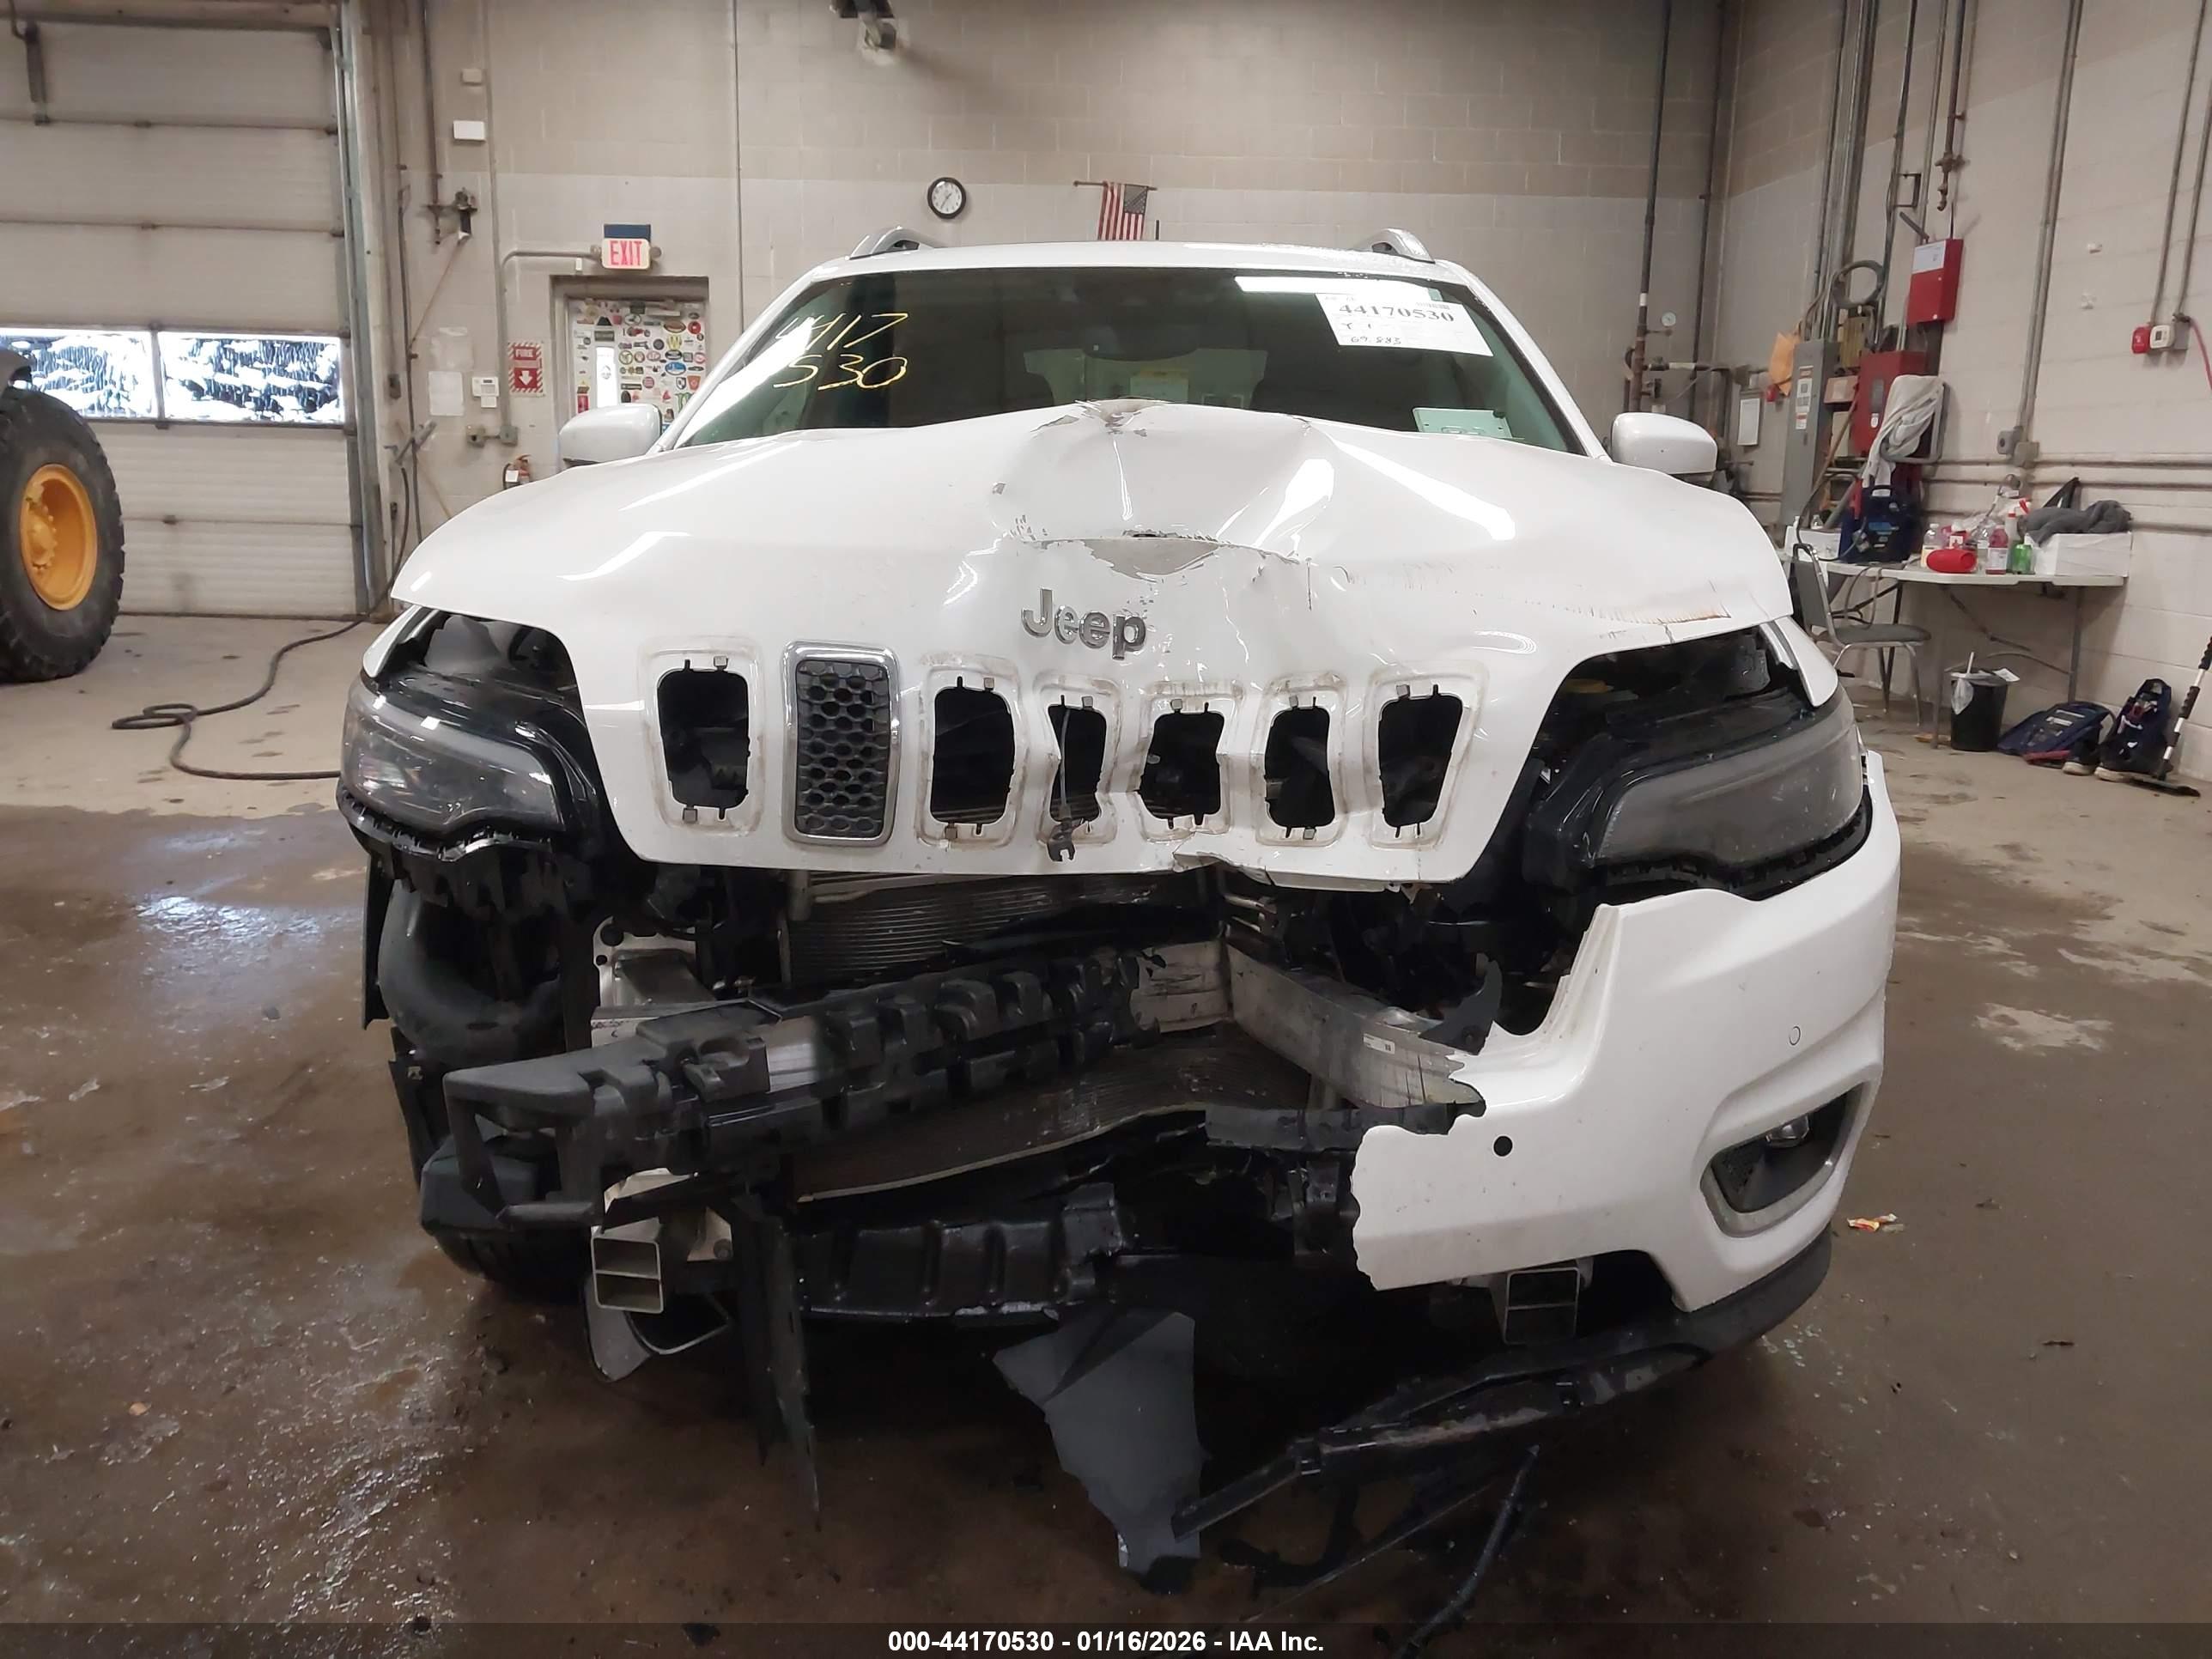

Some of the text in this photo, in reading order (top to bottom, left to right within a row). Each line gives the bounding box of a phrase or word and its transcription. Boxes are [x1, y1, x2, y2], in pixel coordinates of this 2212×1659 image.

[610, 240, 642, 266] EXIT
[1339, 304, 1455, 323] 44170530
[773, 354, 909, 391] 530
[1020, 587, 1147, 661] Jeep
